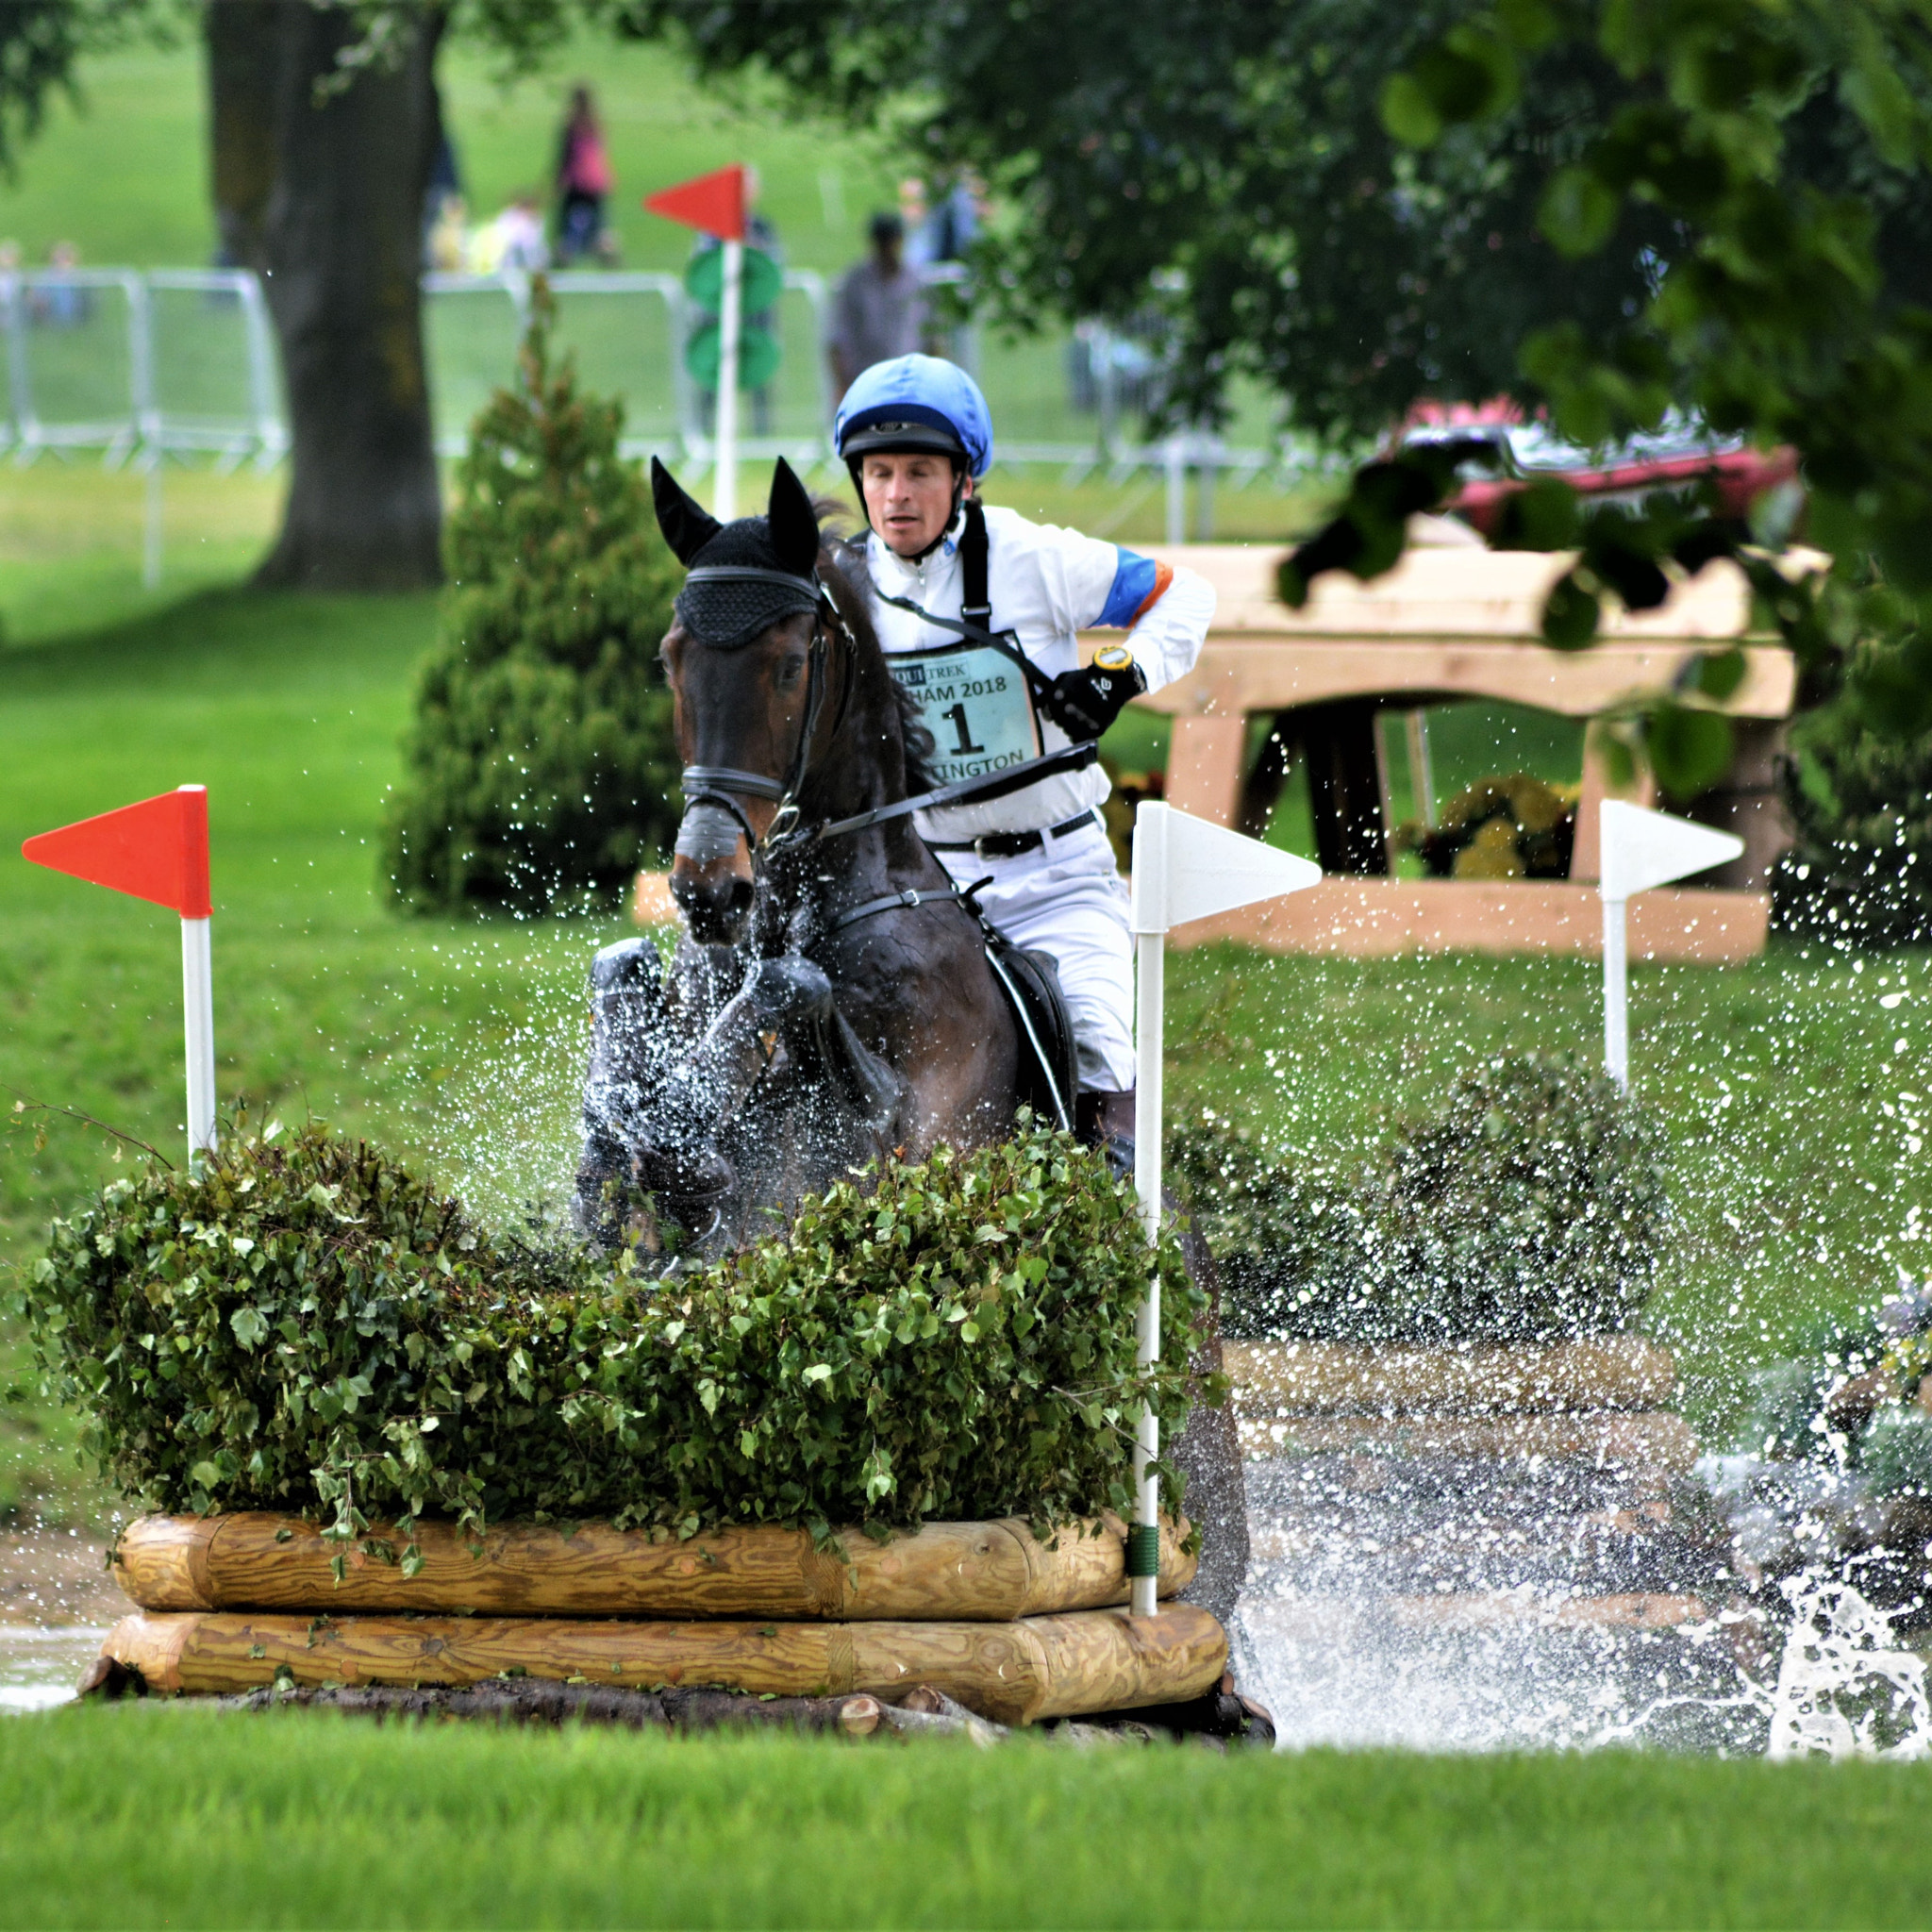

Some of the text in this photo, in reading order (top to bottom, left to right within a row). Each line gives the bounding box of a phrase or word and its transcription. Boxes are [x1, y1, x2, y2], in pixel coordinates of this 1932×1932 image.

[894, 668, 924, 685] QUI
[909, 676, 1008, 704] HAM 2018
[941, 703, 985, 756] 1
[940, 748, 1024, 779] INGTON
